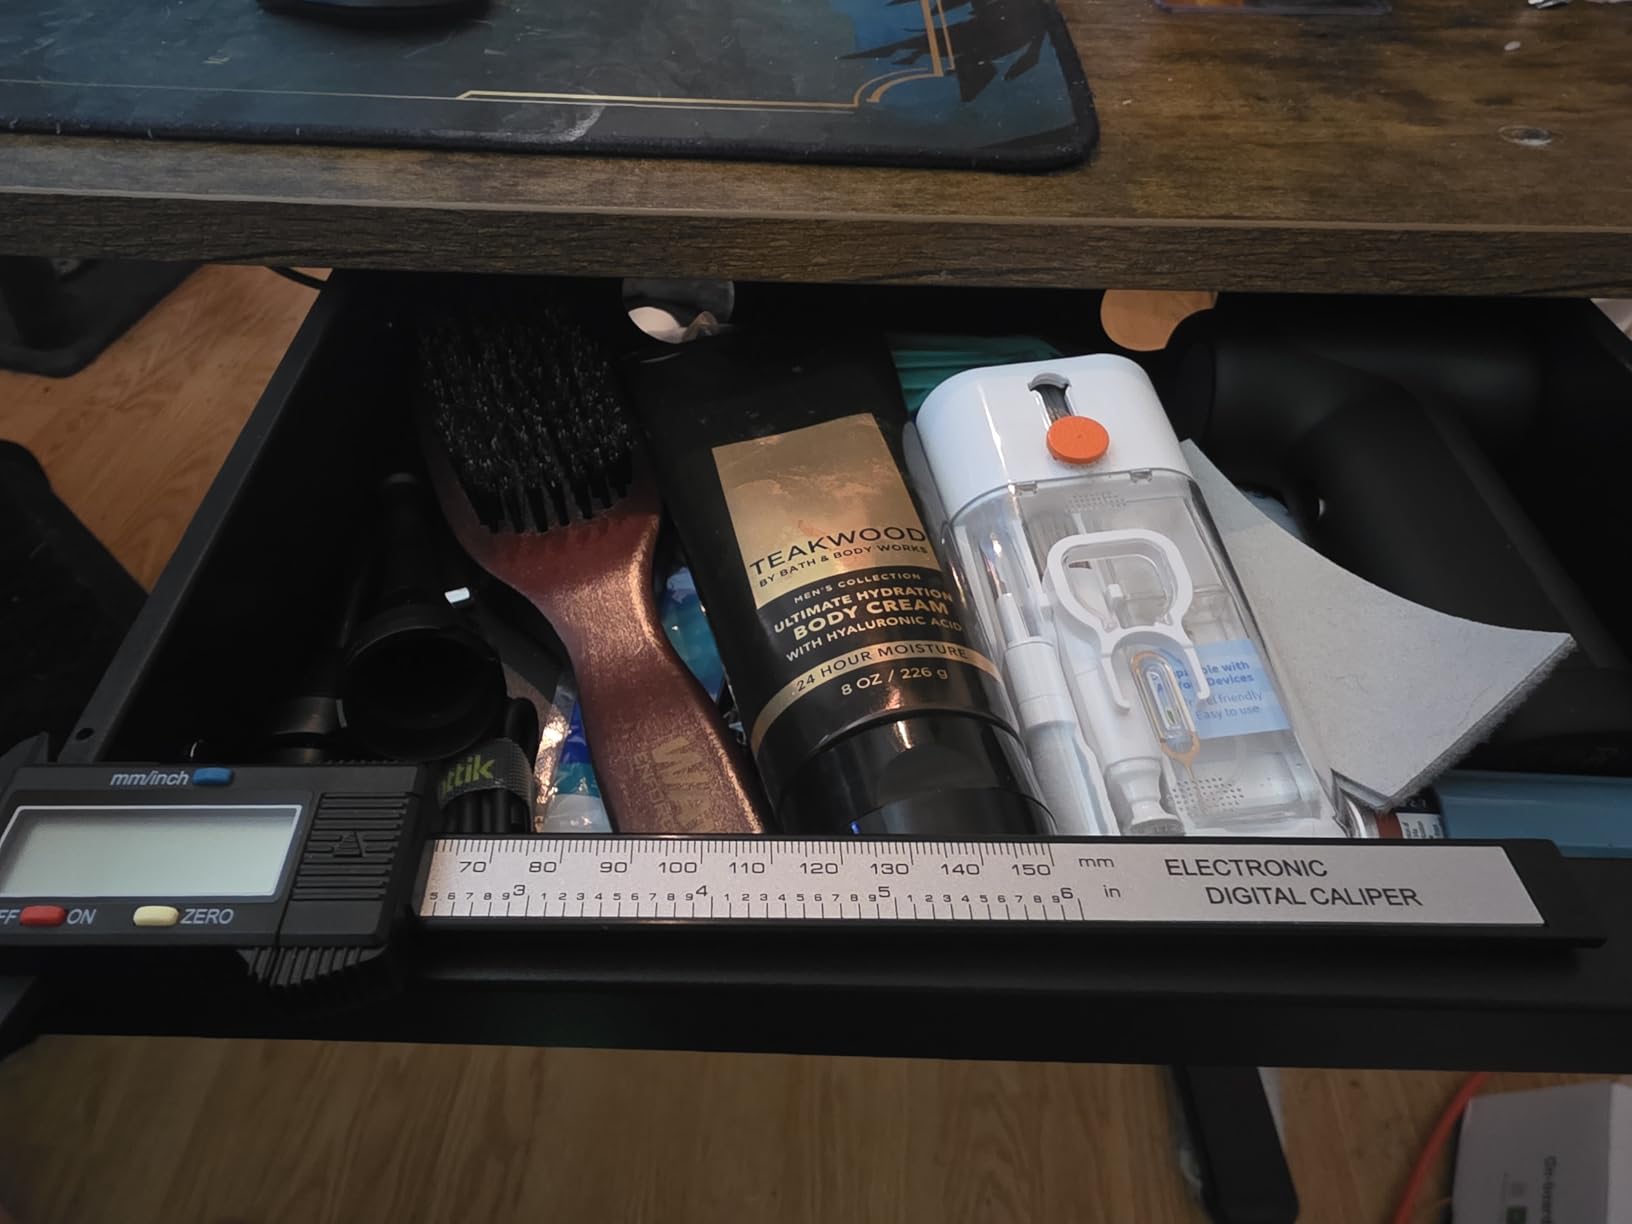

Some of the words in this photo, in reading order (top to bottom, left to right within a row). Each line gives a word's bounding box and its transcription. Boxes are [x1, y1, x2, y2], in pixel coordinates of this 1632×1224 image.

[749, 526, 926, 576] TEAKWOOD
[759, 573, 779, 588] BY
[780, 558, 817, 578] BATH
[820, 555, 830, 563] &
[833, 545, 873, 560] BODY
[877, 544, 928, 554] WORKS
[794, 584, 833, 604] MEN'S
[838, 573, 921, 588] COLLECTION
[774, 594, 853, 633] ULTIMATE
[856, 586, 953, 602] HYDRATION
[793, 605, 858, 641] BODY
[866, 599, 949, 615] CREAM
[786, 637, 823, 663] WITH
[827, 616, 927, 642] HYALURONIC
[931, 617, 962, 632] ACID
[796, 674, 816, 692] 24
[821, 652, 873, 679] HOUR
[877, 643, 969, 660] MOISTURE
[1221, 661, 1250, 673] with
[841, 683, 853, 696] 8
[856, 673, 883, 689] OZ
[888, 669, 895, 683] /
[901, 667, 933, 680] 226
[937, 670, 948, 680] g
[1239, 705, 1261, 716] use
[109, 769, 190, 787] mm/inch
[459, 861, 487, 873] 70
[529, 861, 557, 873] 80
[600, 861, 628, 873] 90
[658, 862, 698, 874] 100
[729, 862, 765, 874] 110
[799, 862, 839, 875] 120
[870, 863, 910, 875] 130
[940, 863, 980, 876] 140
[1011, 864, 1051, 876] 150
[1078, 858, 1115, 868] mm
[1164, 858, 1328, 877] ELECTRONIC
[430, 892, 438, 900] 5
[448, 892, 456, 900] 6
[466, 892, 474, 900] 7
[484, 892, 492, 900] 8
[502, 892, 510, 900] 9
[513, 884, 526, 896] 3
[558, 892, 567, 900] 2
[576, 892, 585, 900] 3
[613, 893, 621, 901] 5
[631, 893, 639, 901] 6
[649, 893, 657, 901] 7
[667, 893, 675, 901] 8
[685, 893, 694, 901] 9
[695, 885, 708, 897] 4
[742, 893, 750, 901] 2
[760, 893, 768, 901] 3
[778, 893, 786, 901] 4
[796, 894, 804, 902] 5
[814, 894, 822, 902] 6
[832, 894, 840, 902] 7
[850, 894, 858, 902] 8
[868, 894, 877, 902] 9
[878, 886, 891, 898] 5
[925, 895, 933, 903] 2
[943, 895, 952, 903] 3
[961, 895, 970, 903] 4
[979, 895, 988, 903] 5
[997, 895, 1006, 903] 6
[1015, 895, 1023, 903] 7
[1033, 895, 1042, 904] 8
[1051, 895, 1061, 904] 9
[1060, 887, 1074, 899] 6
[1102, 884, 1121, 898] in
[1205, 886, 1307, 906] DIGITAL
[1310, 887, 1424, 907] CALIPER
[0, 909, 20, 925] FF
[67, 908, 97, 925] ON
[180, 907, 234, 925] ZERO
